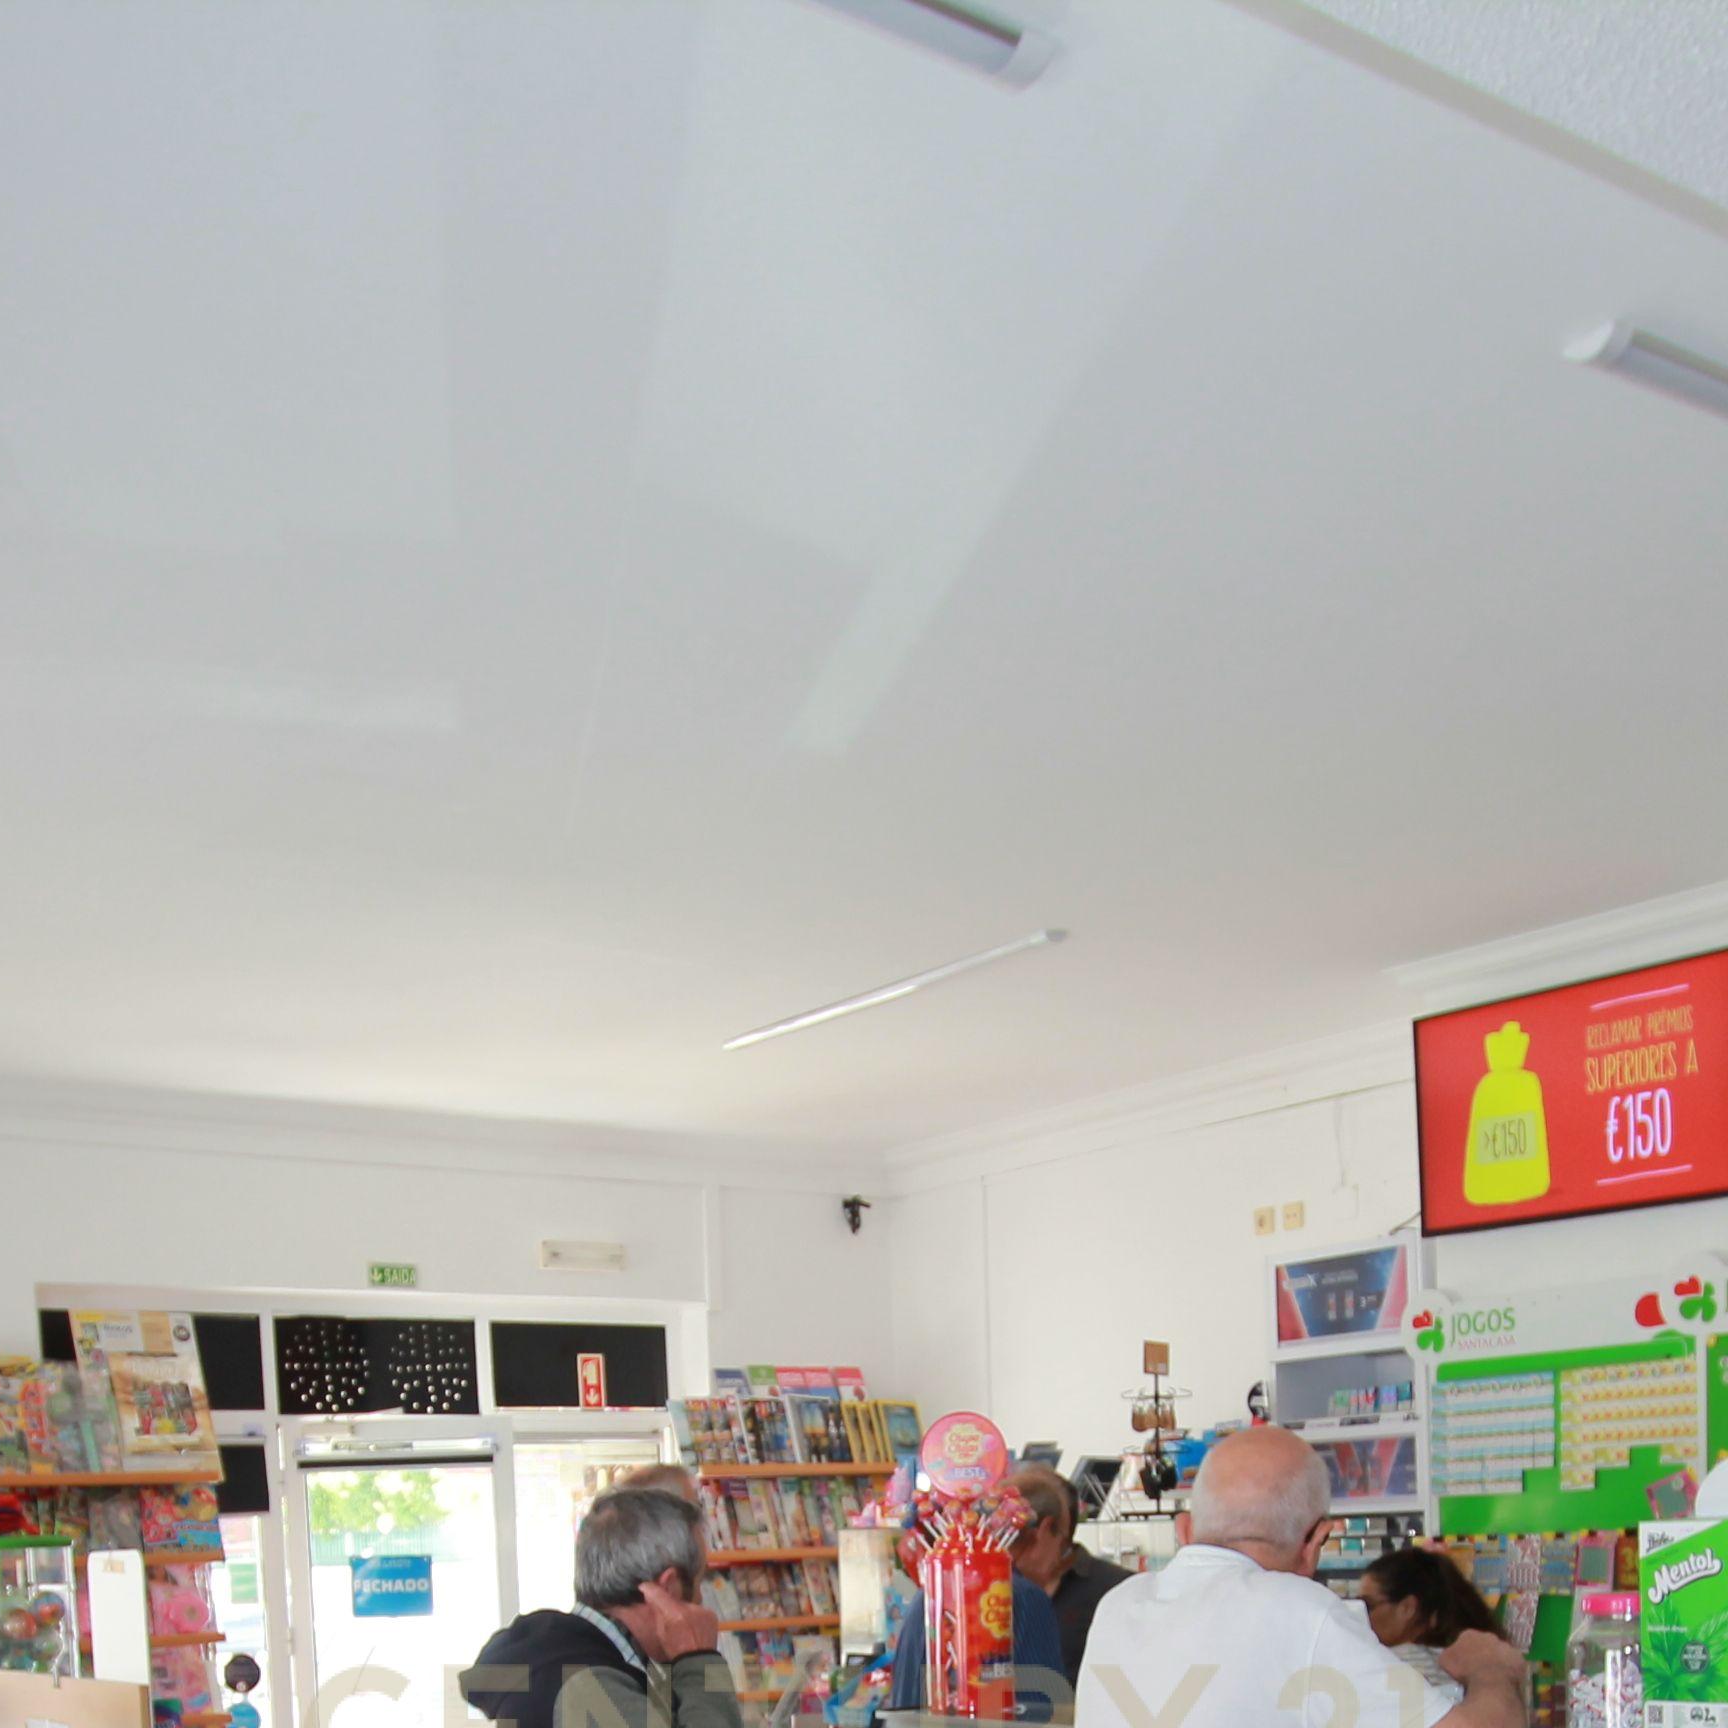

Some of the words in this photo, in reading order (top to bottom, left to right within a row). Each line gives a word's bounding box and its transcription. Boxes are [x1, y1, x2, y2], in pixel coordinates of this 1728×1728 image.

[1585, 1041, 1677, 1093] SUPERIORES
[1686, 1037, 1699, 1073] A
[1606, 1087, 1672, 1163] €150
[1451, 1307, 1516, 1347] JOGOS
[352, 1578, 428, 1593] FECHADO
[1647, 1547, 1722, 1604] Mentol
